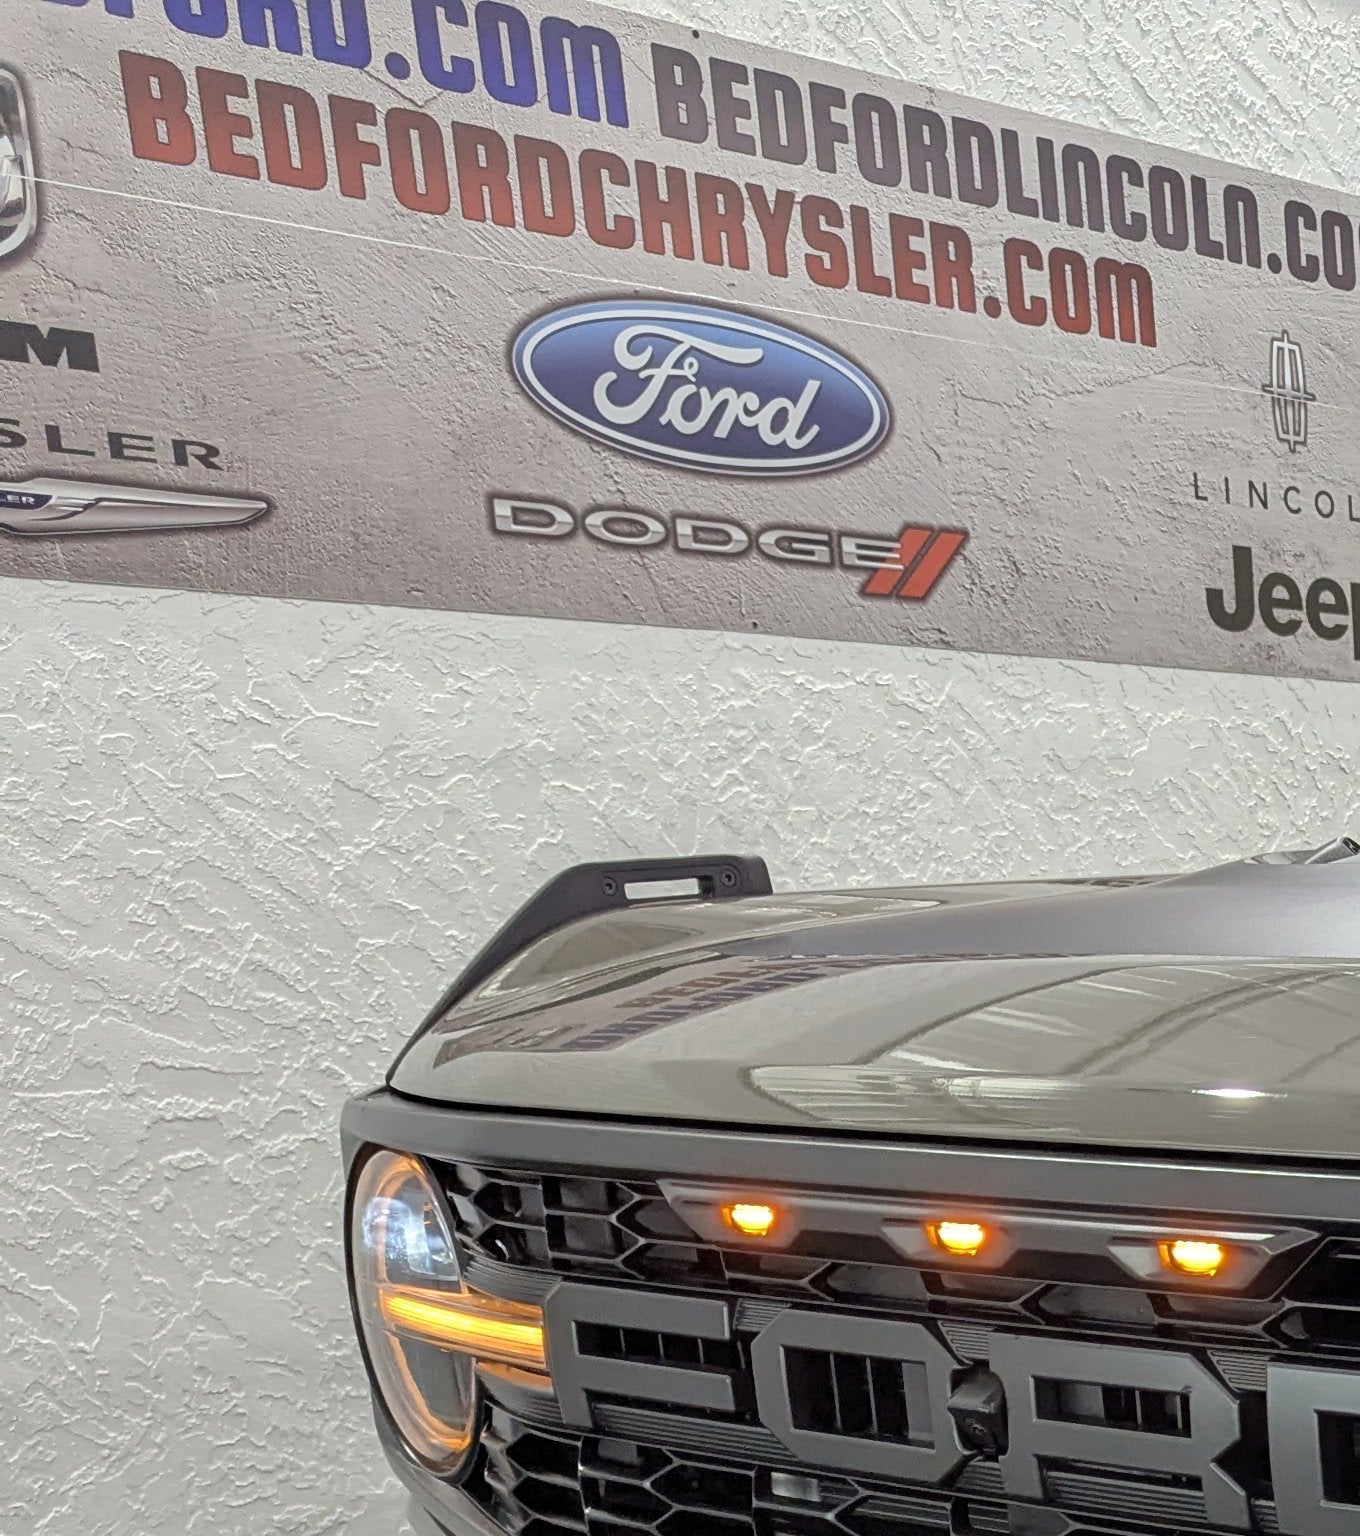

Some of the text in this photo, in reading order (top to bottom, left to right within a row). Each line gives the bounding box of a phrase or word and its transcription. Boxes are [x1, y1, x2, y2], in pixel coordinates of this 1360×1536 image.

[118, 49, 1157, 348] BEDFORDCHRYSLER.COM
[593, 324, 822, 450] Ford
[491, 496, 905, 574] DODGE
